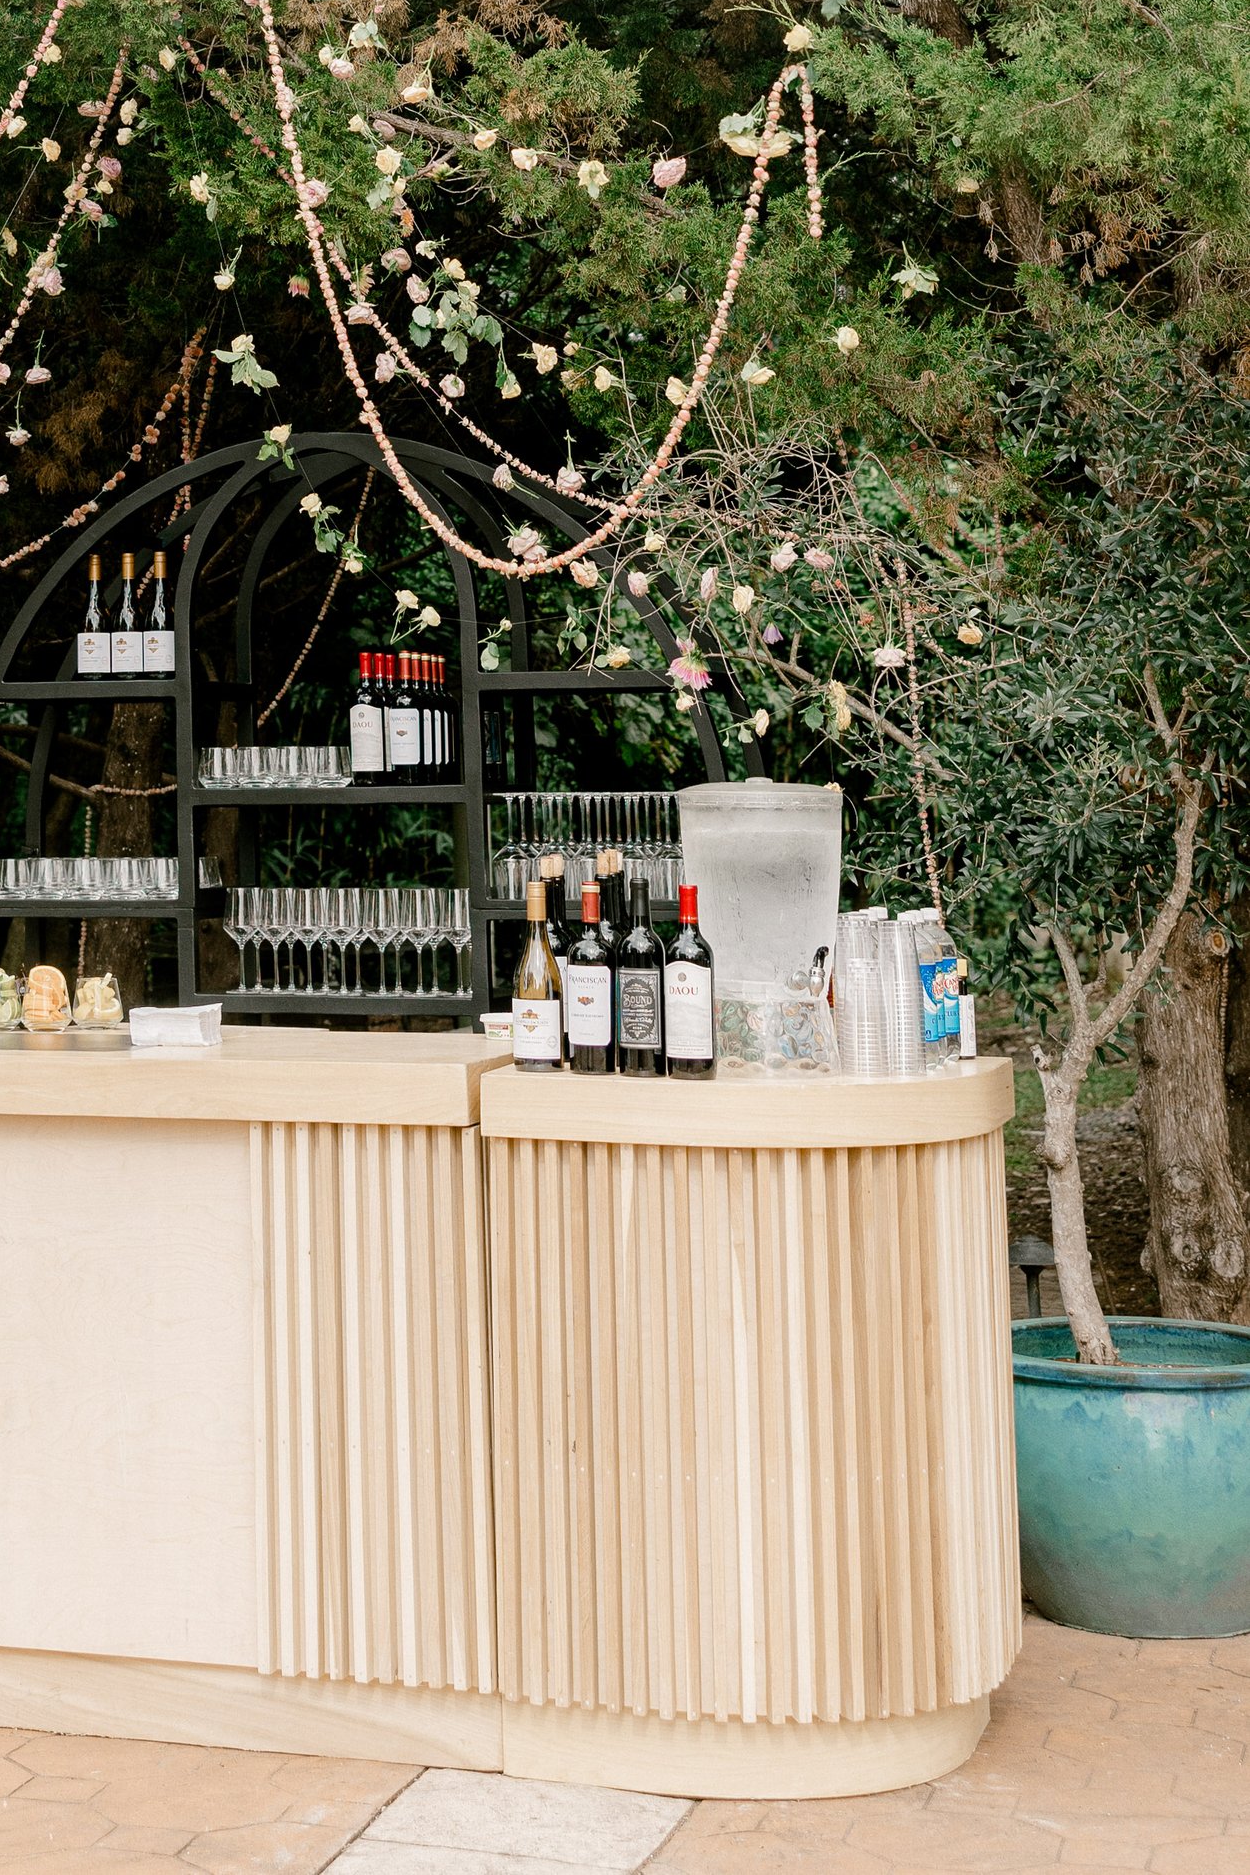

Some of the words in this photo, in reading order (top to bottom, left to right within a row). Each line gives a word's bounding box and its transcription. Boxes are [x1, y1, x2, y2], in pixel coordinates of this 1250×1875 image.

[569, 974, 607, 985] FRANCISCAN
[669, 986, 698, 995] DAOU
[623, 994, 652, 1008] BOUND
